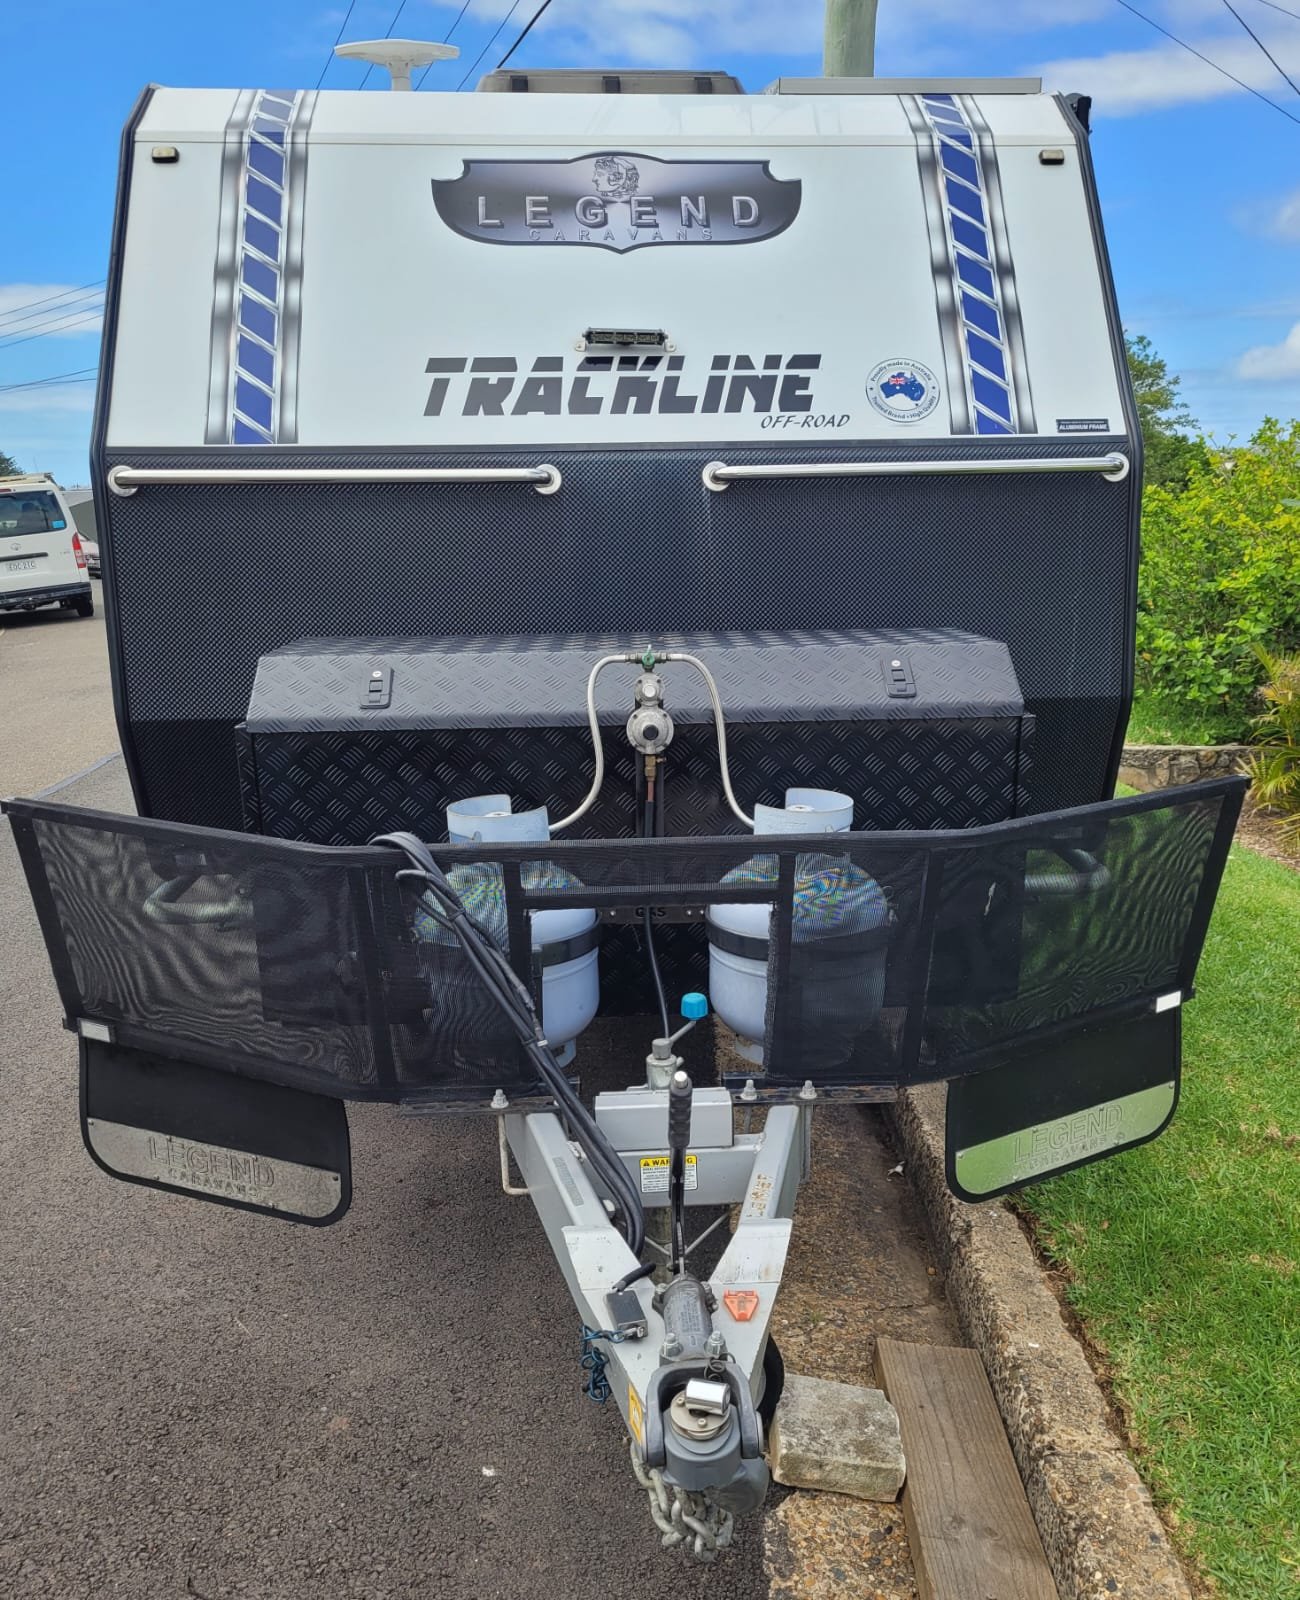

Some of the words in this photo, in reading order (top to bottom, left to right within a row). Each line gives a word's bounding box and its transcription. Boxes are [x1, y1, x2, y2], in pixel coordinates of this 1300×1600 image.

[477, 195, 761, 229] LEGEND
[528, 228, 714, 242] CARAVANS
[423, 353, 822, 417] TRACKLINE
[760, 414, 850, 429] OFF-ROAD
[1014, 1104, 1123, 1163] LEGEND
[148, 1136, 275, 1188] LEGEND
